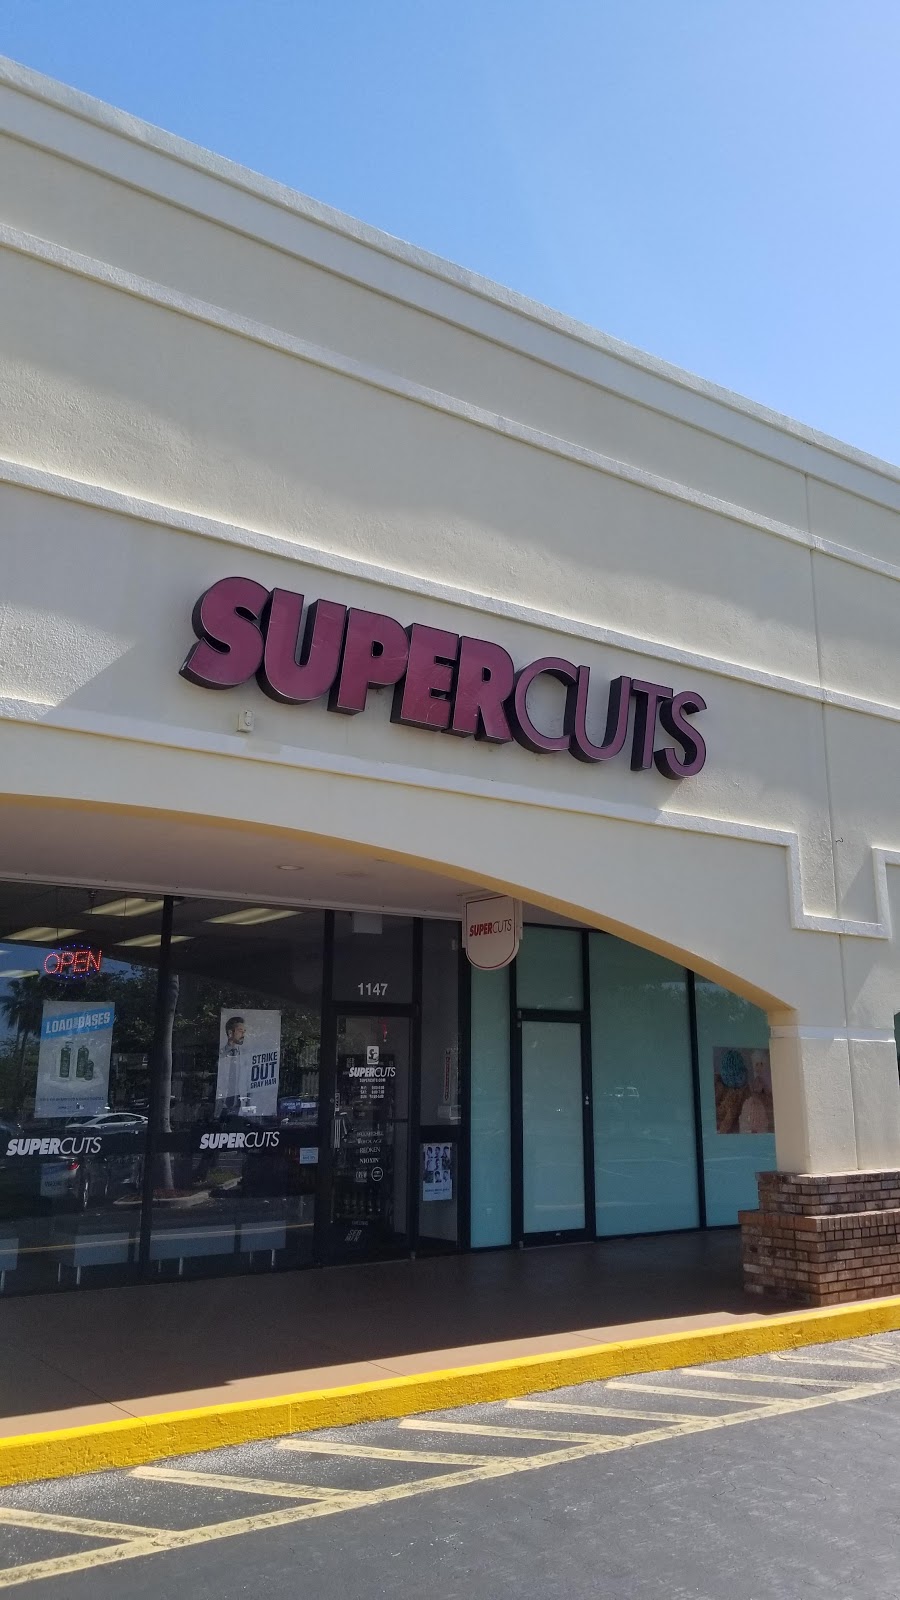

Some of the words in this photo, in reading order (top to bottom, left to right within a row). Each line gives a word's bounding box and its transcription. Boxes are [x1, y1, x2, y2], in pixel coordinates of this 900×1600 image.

[178, 576, 708, 781] SUPERCUTS
[469, 918, 513, 938] SUPERCUTS
[43, 950, 102, 975] OPEN
[357, 982, 388, 996] 1147
[45, 1017, 74, 1034] LOAD
[77, 1011, 111, 1029] BASES
[251, 1051, 278, 1065] STRIKE
[250, 1061, 278, 1082] OUT
[348, 1066, 396, 1078] SUPERCUTS
[6, 1137, 103, 1156] SUPERCUTS
[199, 1131, 280, 1149] SUPERCUTS
